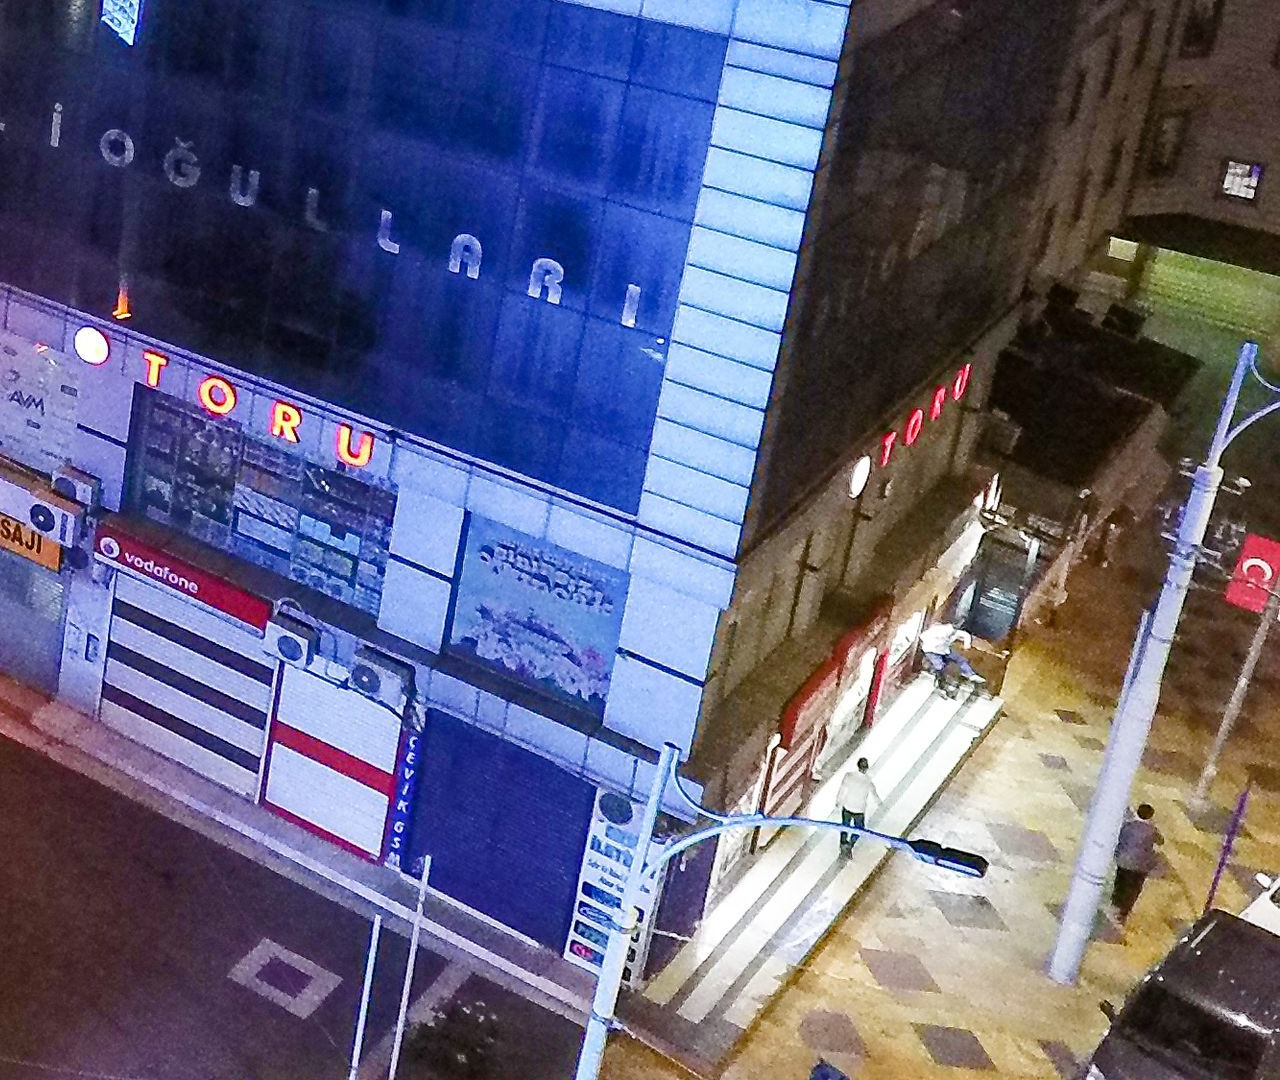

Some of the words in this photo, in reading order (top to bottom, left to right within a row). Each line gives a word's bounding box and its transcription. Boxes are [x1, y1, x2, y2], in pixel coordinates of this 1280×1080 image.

[8, 390, 45, 416] AVM
[142, 348, 376, 467] TORU
[124, 549, 199, 596] vodafone
[387, 821, 406, 867] GSM
